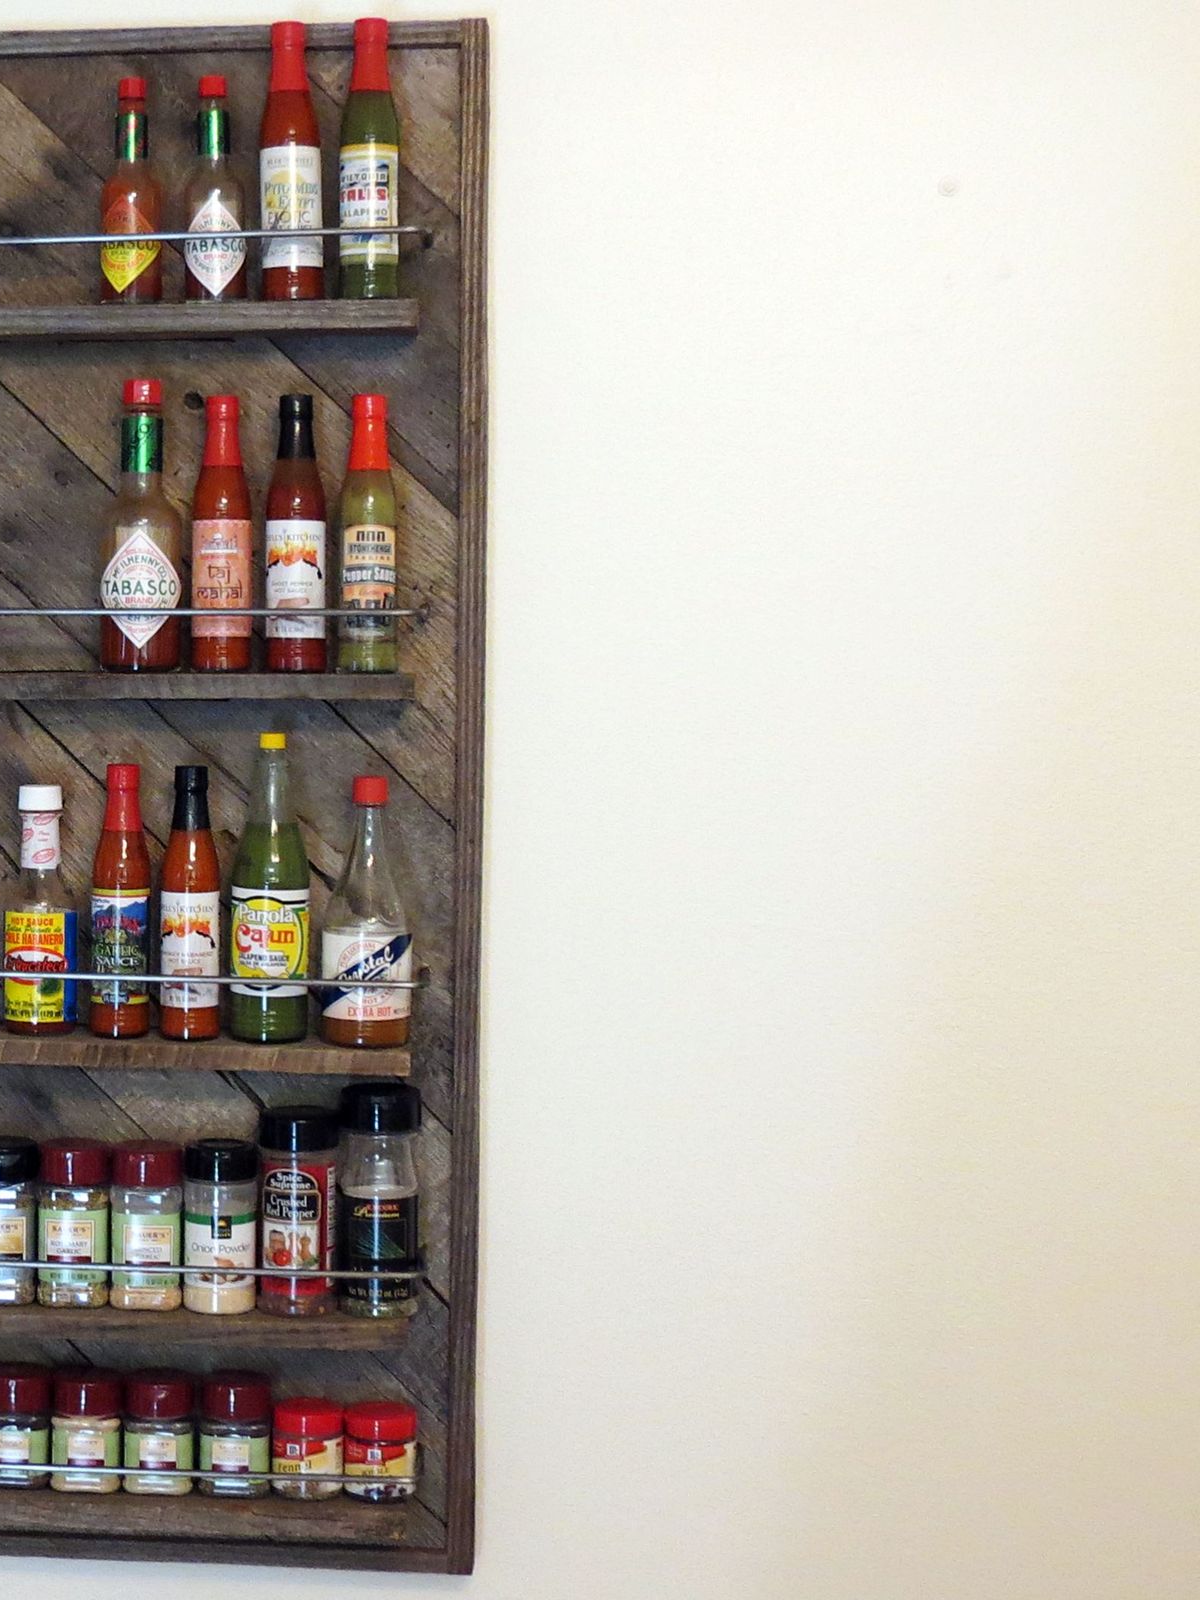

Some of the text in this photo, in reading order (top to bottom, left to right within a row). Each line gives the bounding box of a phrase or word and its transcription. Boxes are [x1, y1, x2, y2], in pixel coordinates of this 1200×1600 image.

[186, 238, 244, 253] TABASCO
[208, 561, 231, 582] taj
[104, 580, 177, 596] TABASCO
[196, 579, 243, 599] mahal
[125, 597, 154, 605] BRAND
[238, 902, 294, 925] Panola
[11, 917, 54, 927] HOT SAUCE
[235, 924, 295, 953] Cajun
[96, 956, 140, 967] SAUCE
[377, 1006, 392, 1017] HOT
[269, 1178, 311, 1190] Supreme
[277, 1171, 303, 1183] Spice
[270, 1193, 308, 1208] Crushed
[266, 1202, 315, 1220] Red Pepper
